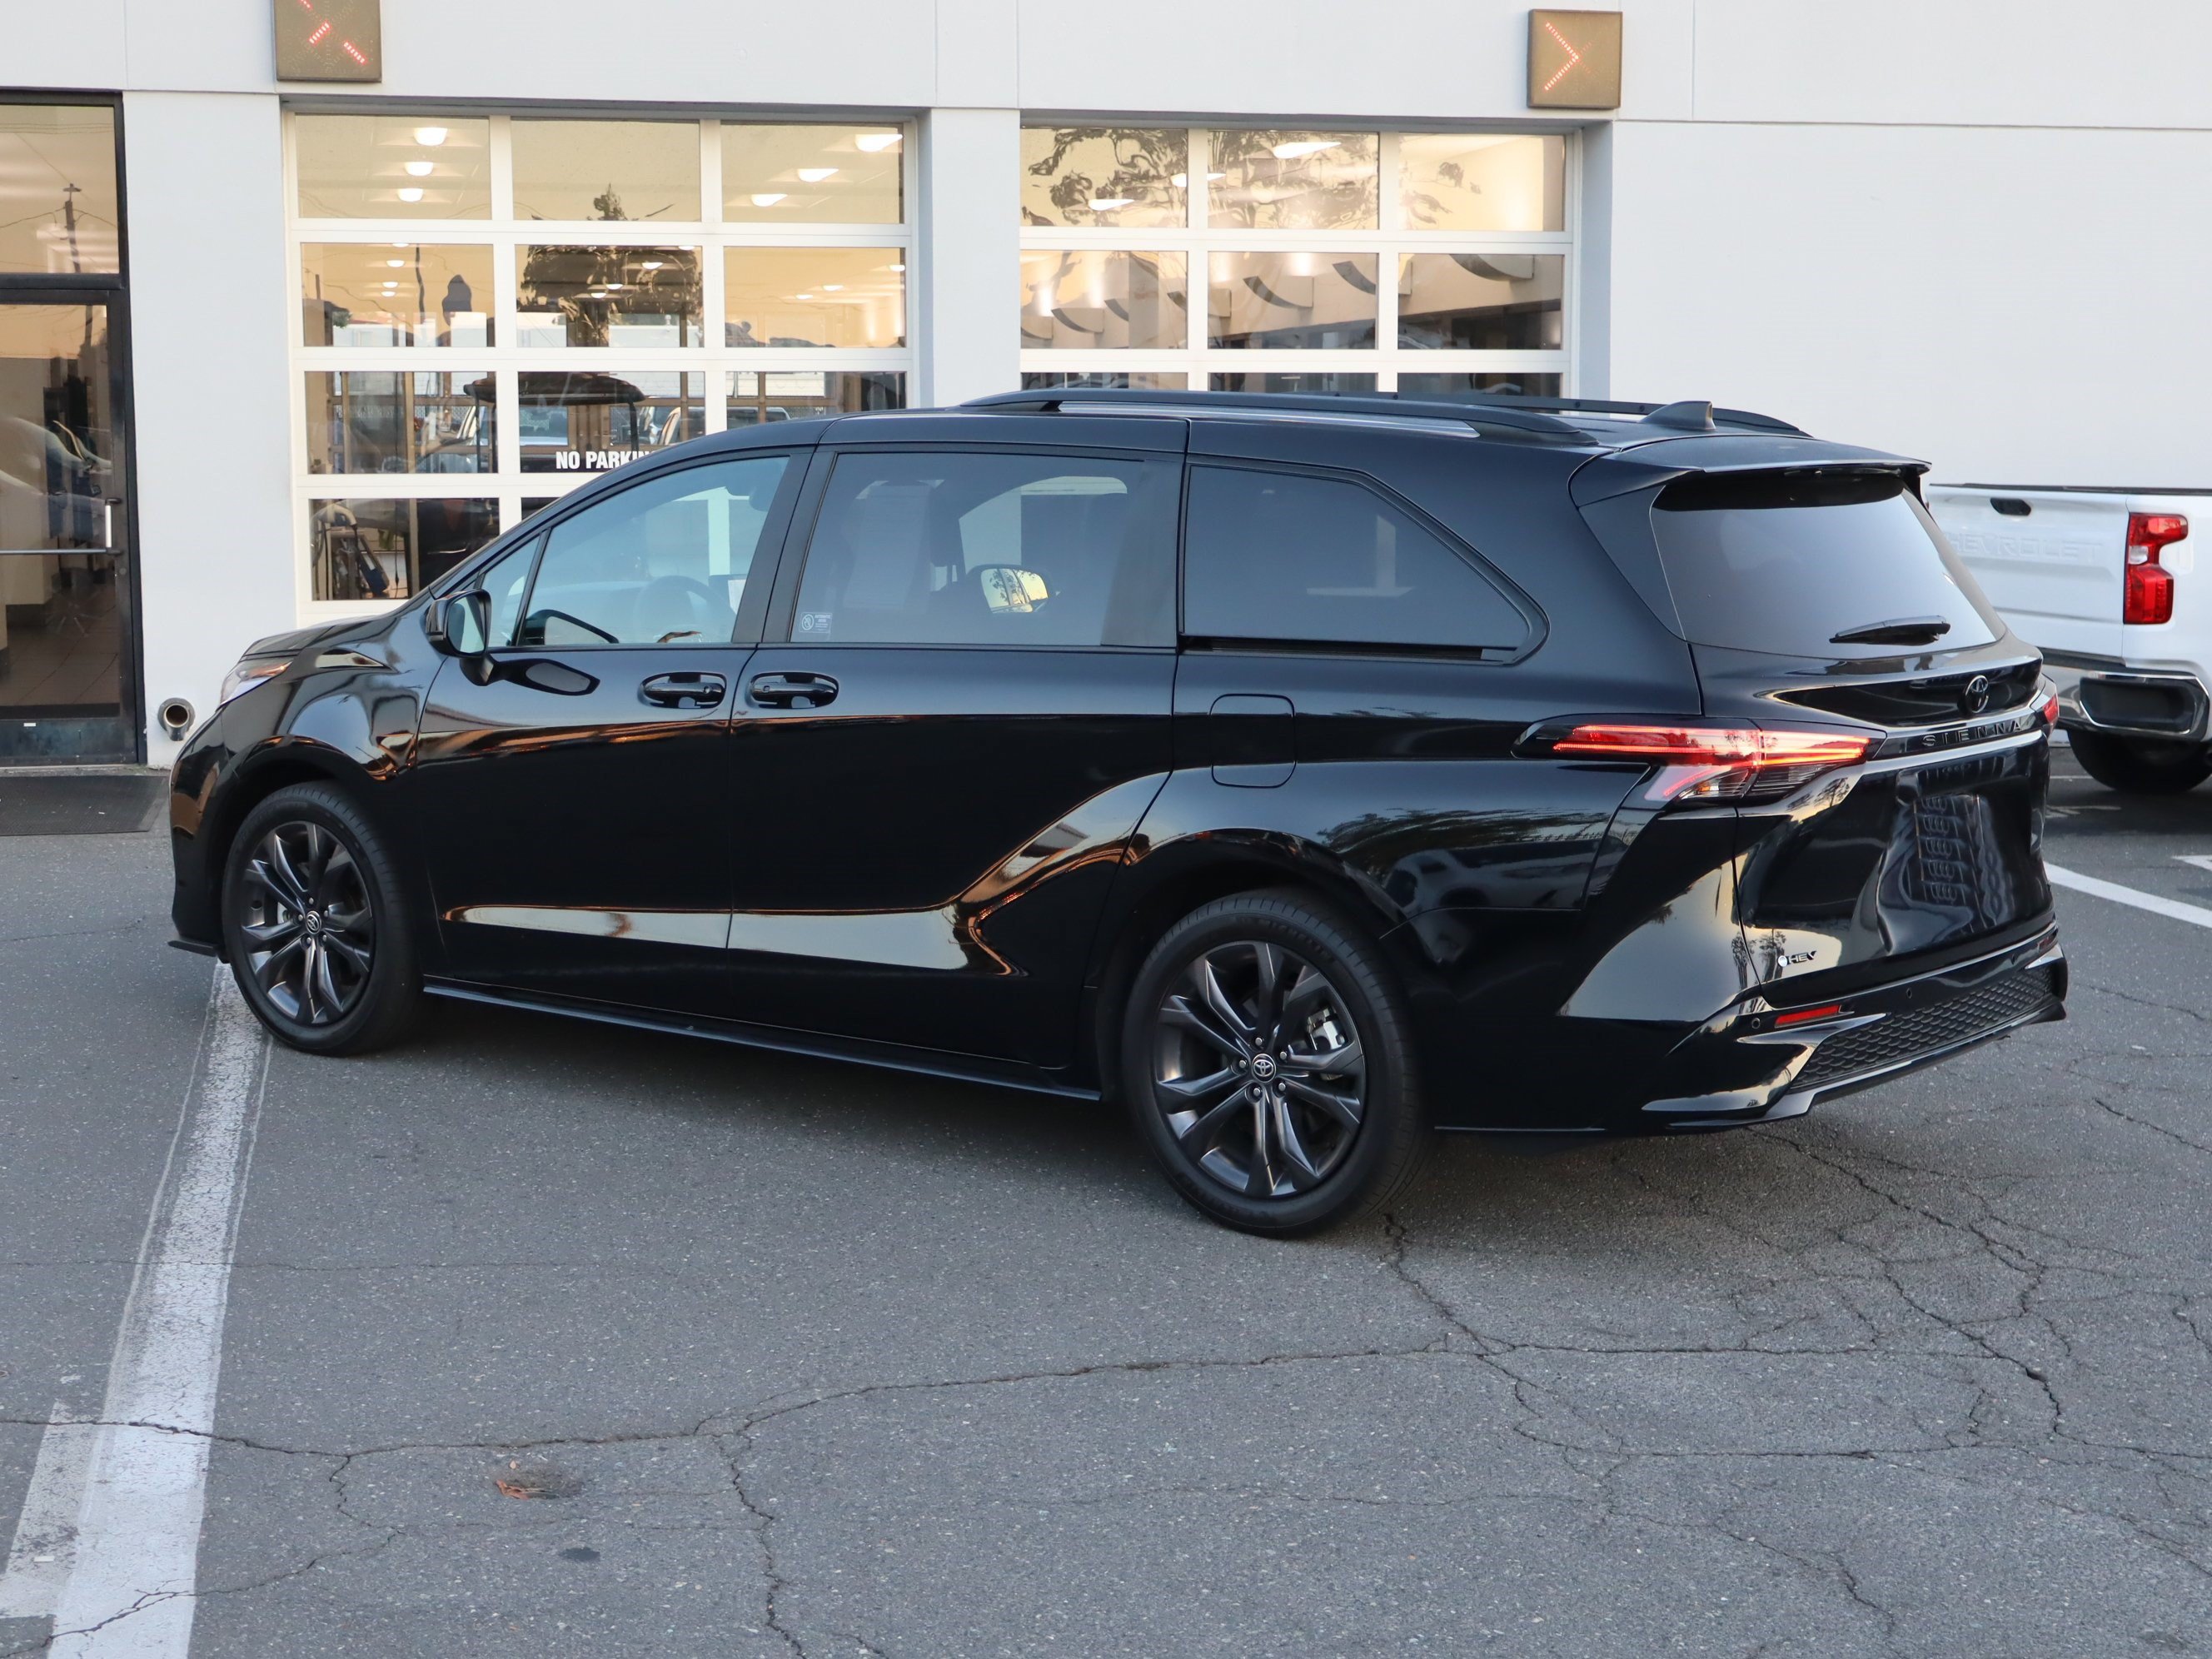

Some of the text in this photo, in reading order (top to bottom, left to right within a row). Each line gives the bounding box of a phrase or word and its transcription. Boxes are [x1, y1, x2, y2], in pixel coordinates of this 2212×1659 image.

[555, 451, 653, 469] NO PARKI
[1943, 531, 2103, 564] HEVROLET
[1921, 720, 2023, 747] SIENNA
[1787, 950, 1817, 964] HEV
